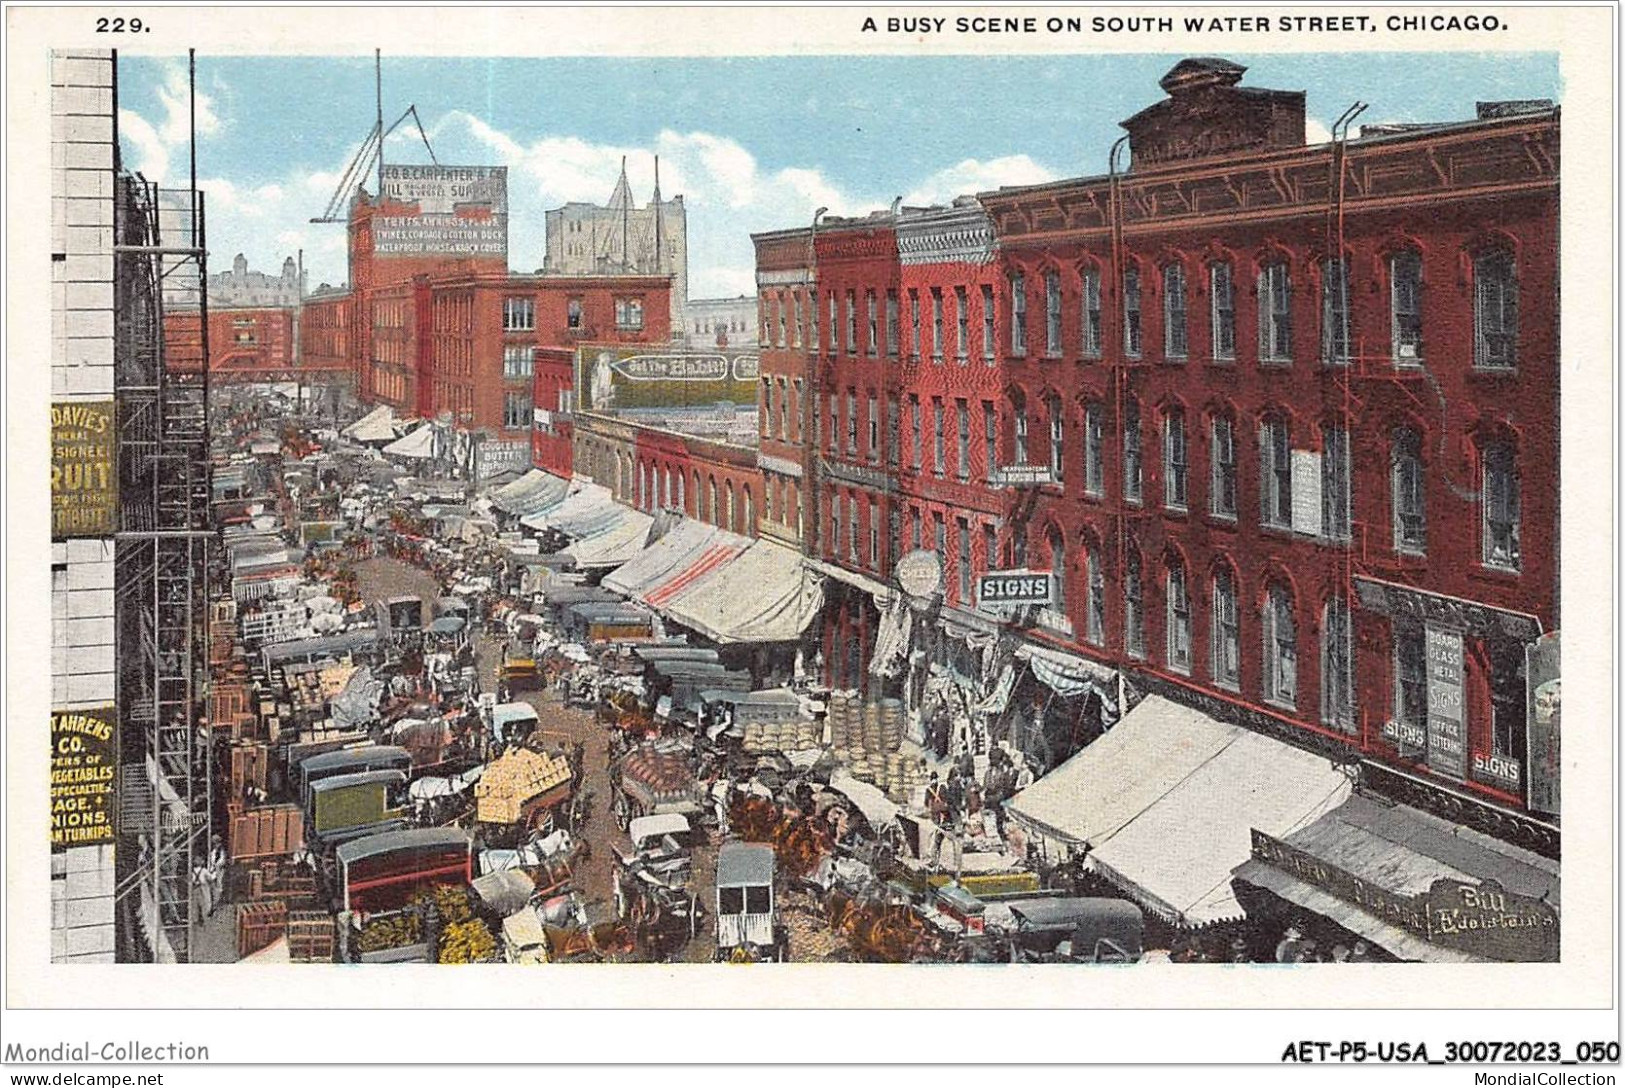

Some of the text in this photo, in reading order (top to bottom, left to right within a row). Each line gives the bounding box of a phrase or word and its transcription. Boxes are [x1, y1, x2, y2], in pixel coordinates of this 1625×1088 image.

[982, 578, 1048, 597] SIGNS
[1429, 647, 1460, 665] GLASS
[1385, 721, 1424, 745] SIGNS
[86, 755, 102, 765] OF
[1475, 754, 1519, 781] SIGNS
[1459, 885, 1505, 912] Bill
